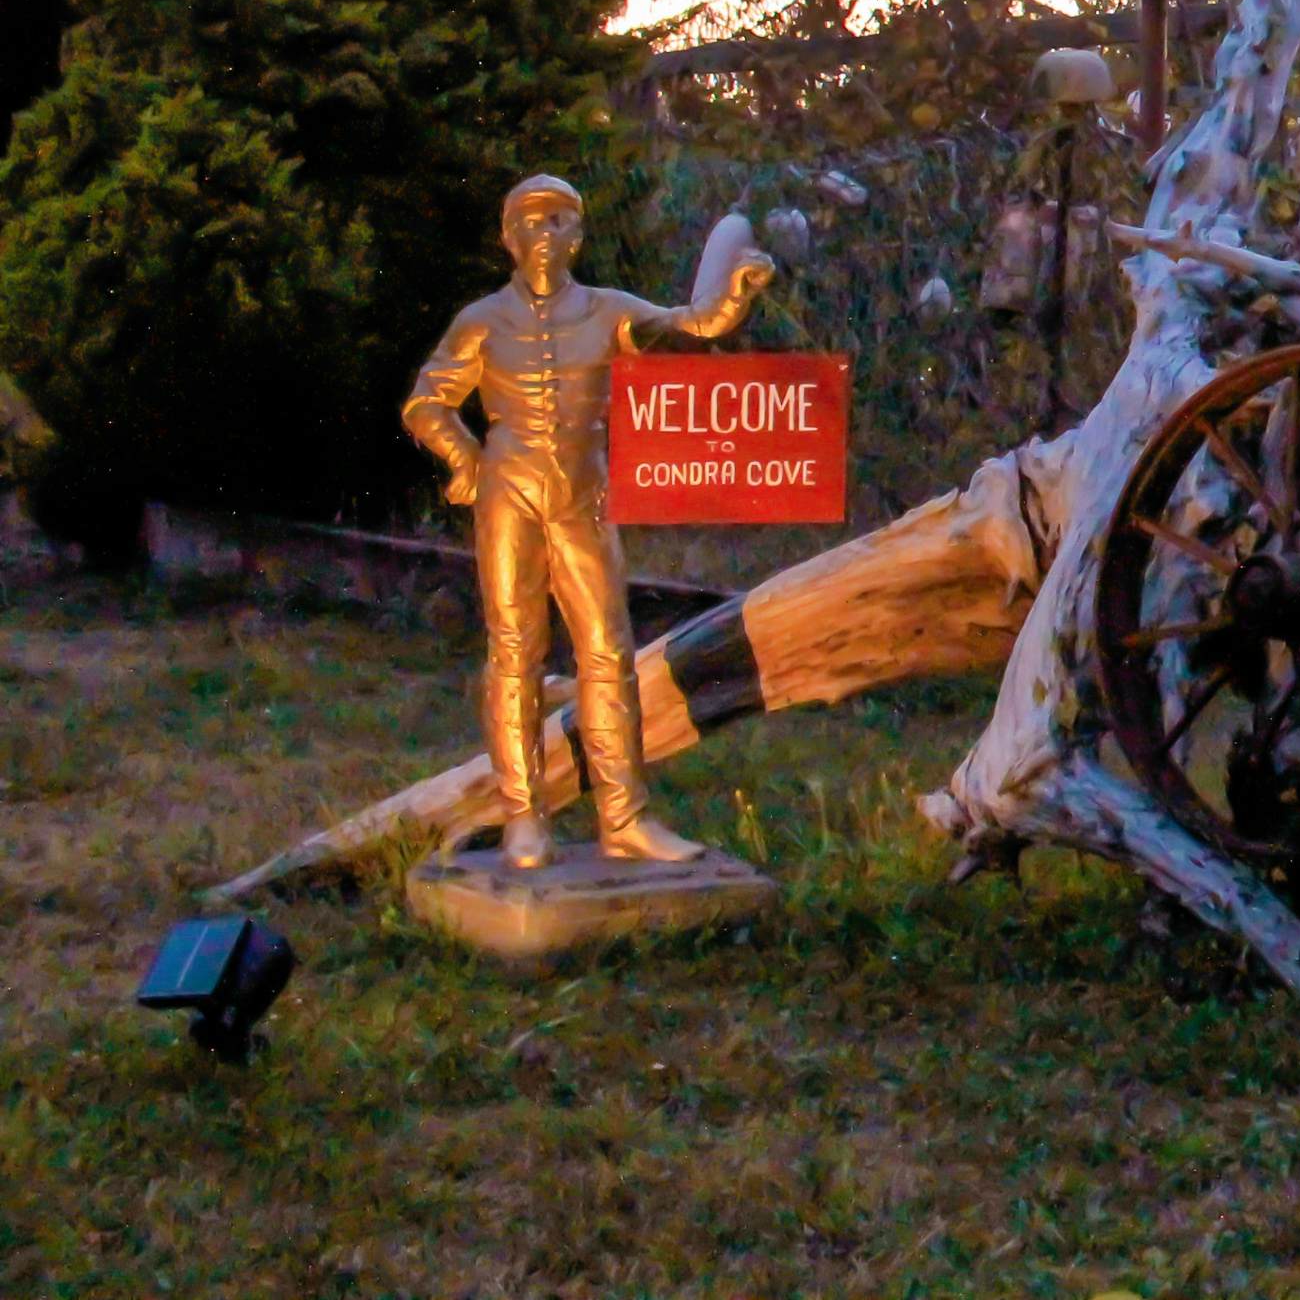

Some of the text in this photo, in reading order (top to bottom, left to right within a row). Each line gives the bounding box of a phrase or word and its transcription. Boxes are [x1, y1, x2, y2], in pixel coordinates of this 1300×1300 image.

[627, 381, 818, 434] WELCOME
[706, 441, 735, 453] TO
[635, 460, 816, 488] CONDRA COVE
